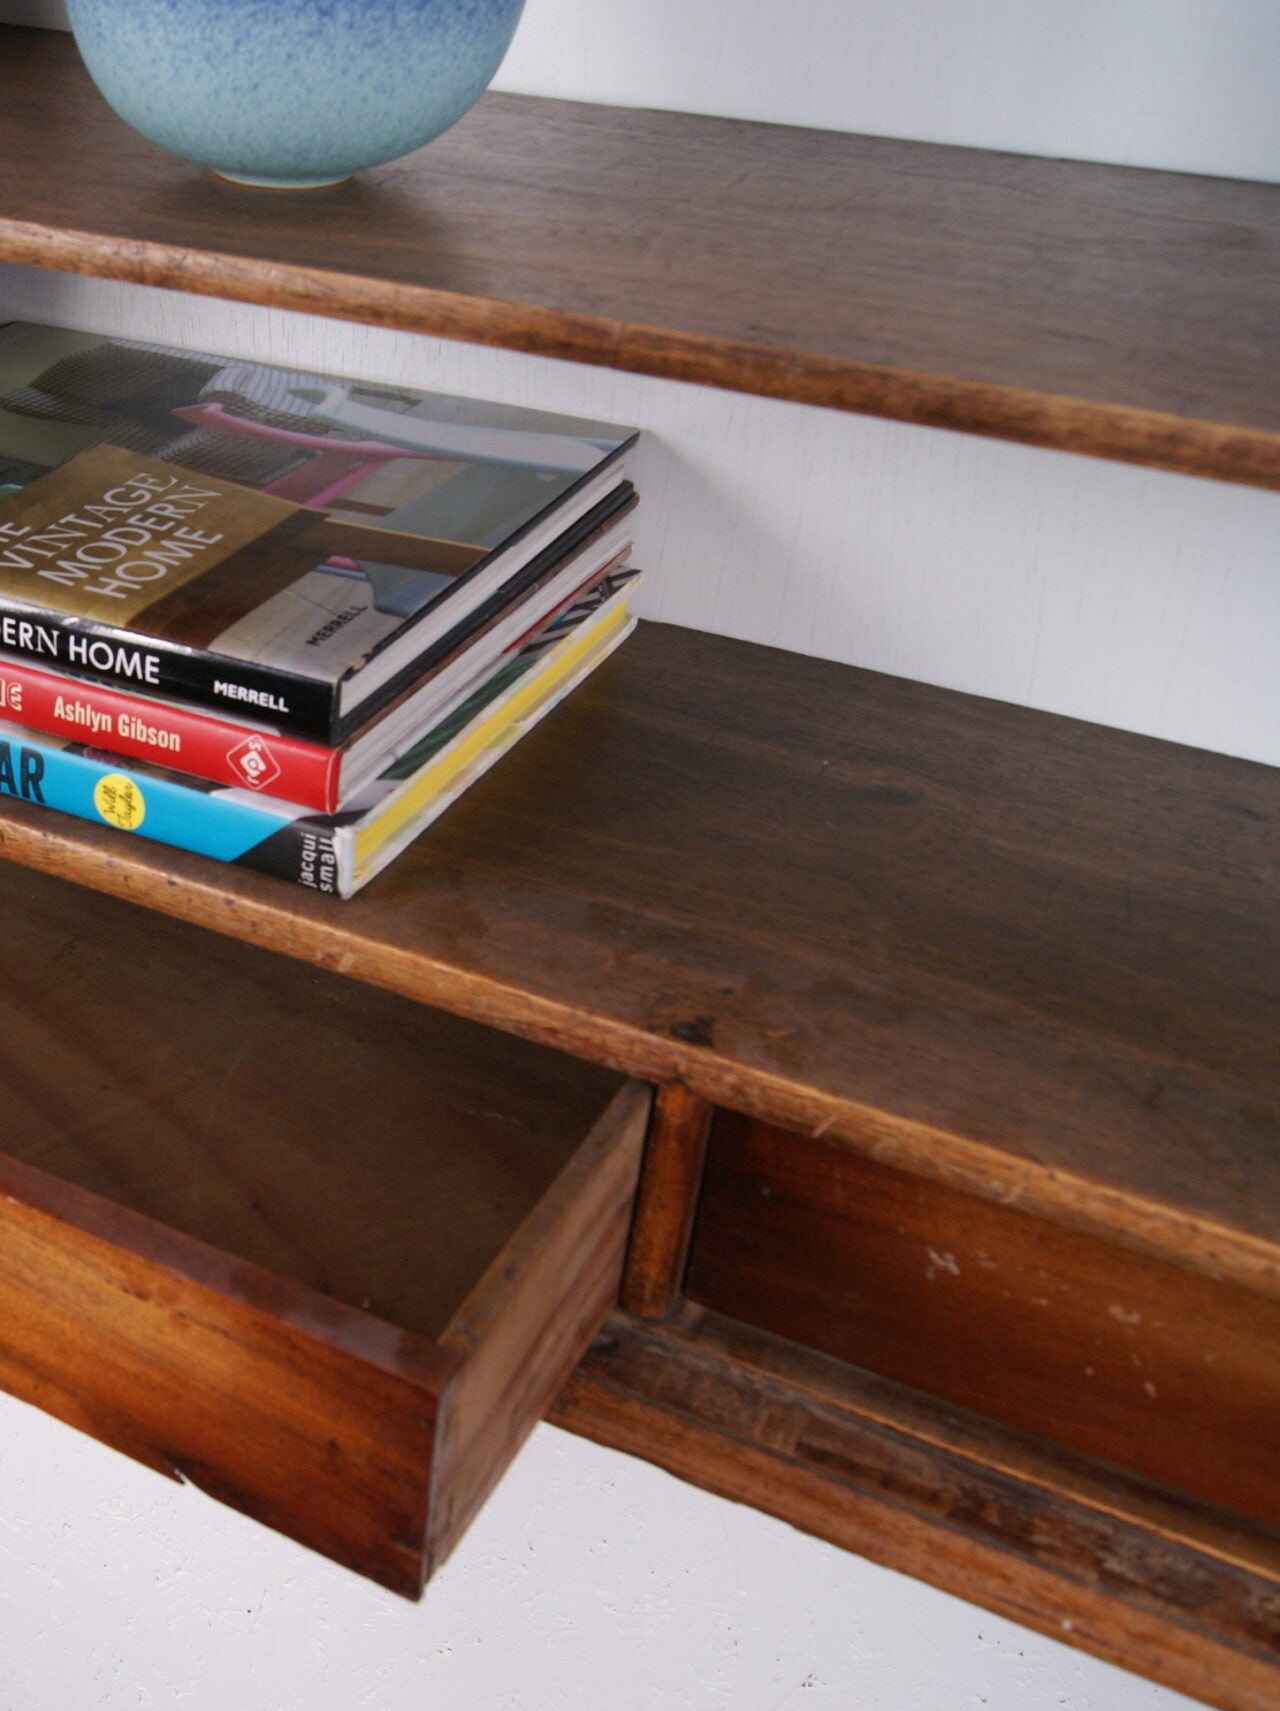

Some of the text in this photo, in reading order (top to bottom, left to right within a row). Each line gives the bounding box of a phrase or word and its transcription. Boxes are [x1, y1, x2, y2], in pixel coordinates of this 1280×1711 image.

[37, 484, 222, 586] MODERN
[83, 526, 224, 599] HOME
[305, 605, 369, 647] MERRELL
[68, 634, 161, 685] HOME
[53, 695, 182, 753] Ashlyn Gibson
[213, 679, 290, 713] MERRELL
[298, 831, 318, 890] jacqui
[318, 836, 336, 894] small
